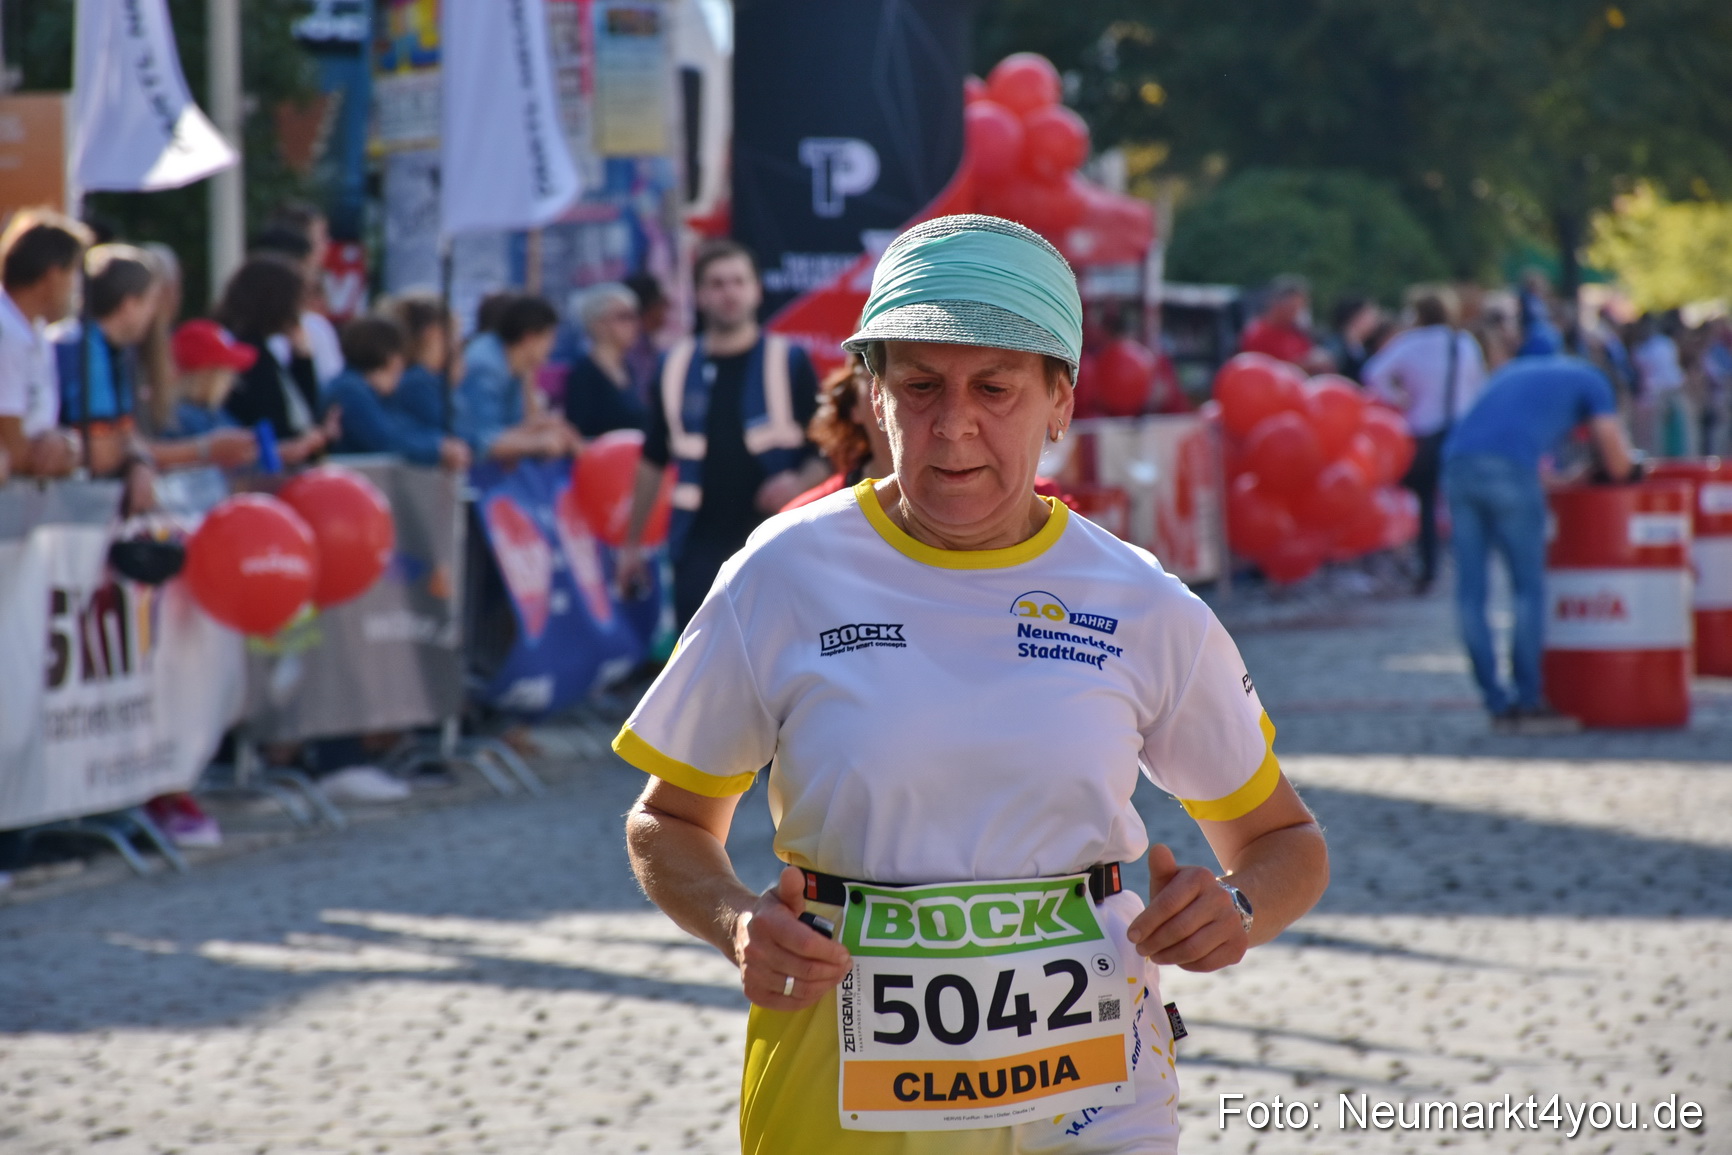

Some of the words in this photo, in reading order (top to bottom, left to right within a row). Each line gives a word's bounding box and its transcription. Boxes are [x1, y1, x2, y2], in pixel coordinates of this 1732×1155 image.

[1018, 601, 1065, 622] 20
[1073, 613, 1114, 632] JAHRE
[820, 623, 906, 651] BOCK
[820, 646, 846, 657] inspired
[847, 645, 855, 653] by
[856, 641, 874, 650] smart
[875, 641, 907, 649] concepts
[1017, 642, 1108, 671] Stadtlauf
[861, 889, 1085, 948] BOCK
[873, 958, 1092, 1046] 5042
[893, 1054, 1080, 1102] CLAUDIA
